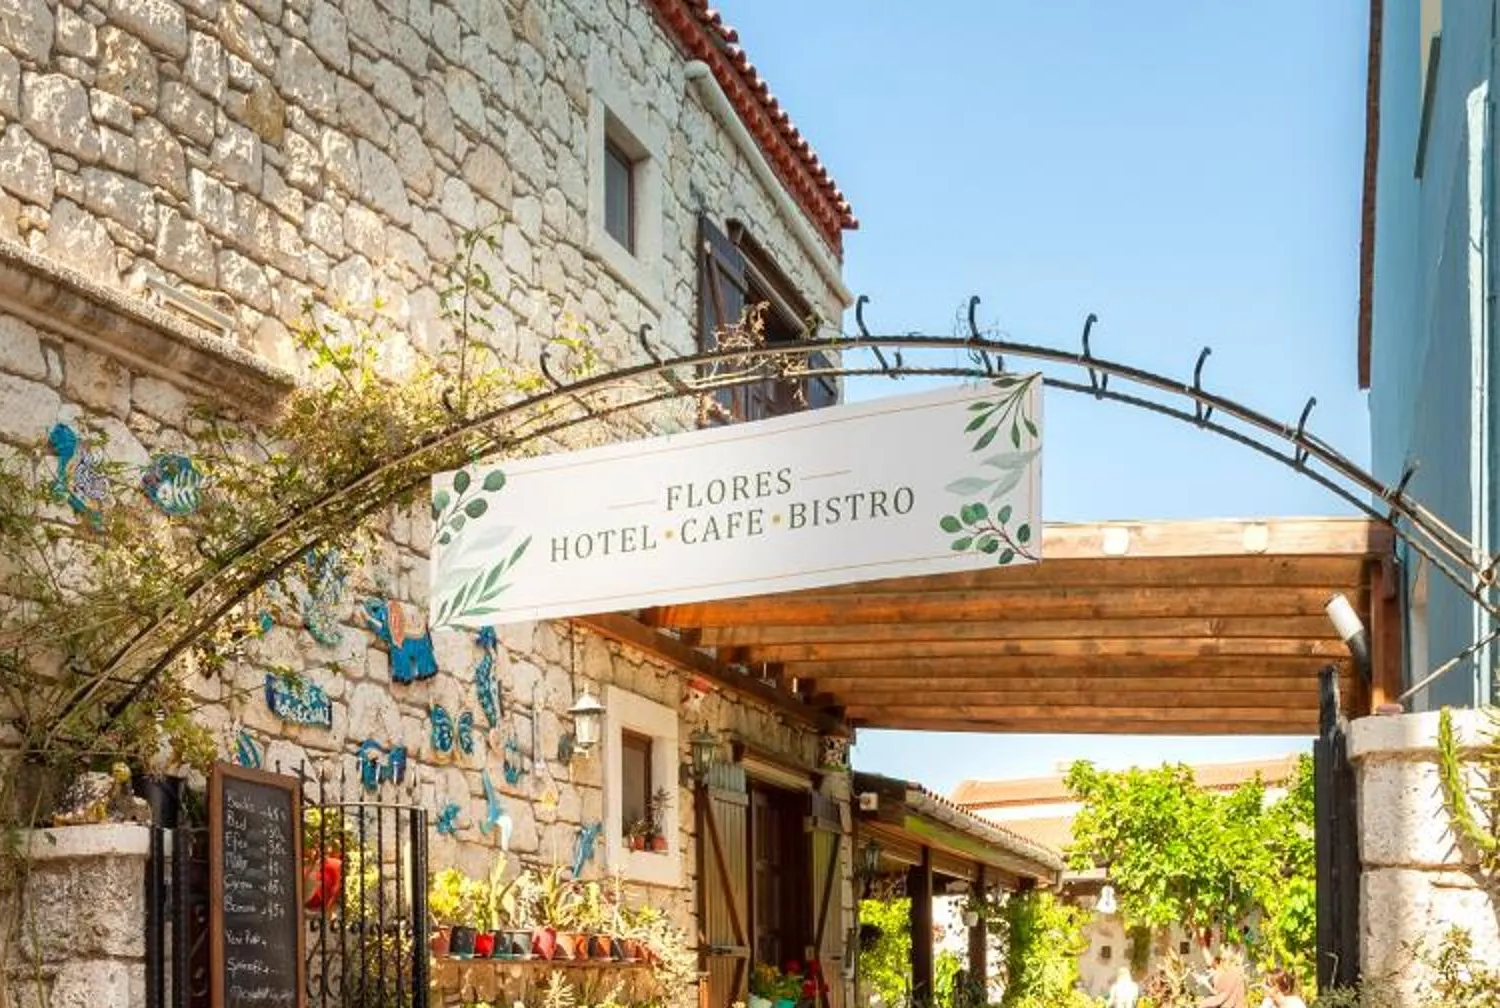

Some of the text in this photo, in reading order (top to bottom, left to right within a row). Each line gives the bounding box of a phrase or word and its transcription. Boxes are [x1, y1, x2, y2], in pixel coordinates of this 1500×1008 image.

[666, 467, 792, 511] FLORES
[550, 487, 916, 563] HOTEL CAFE BISTRO
